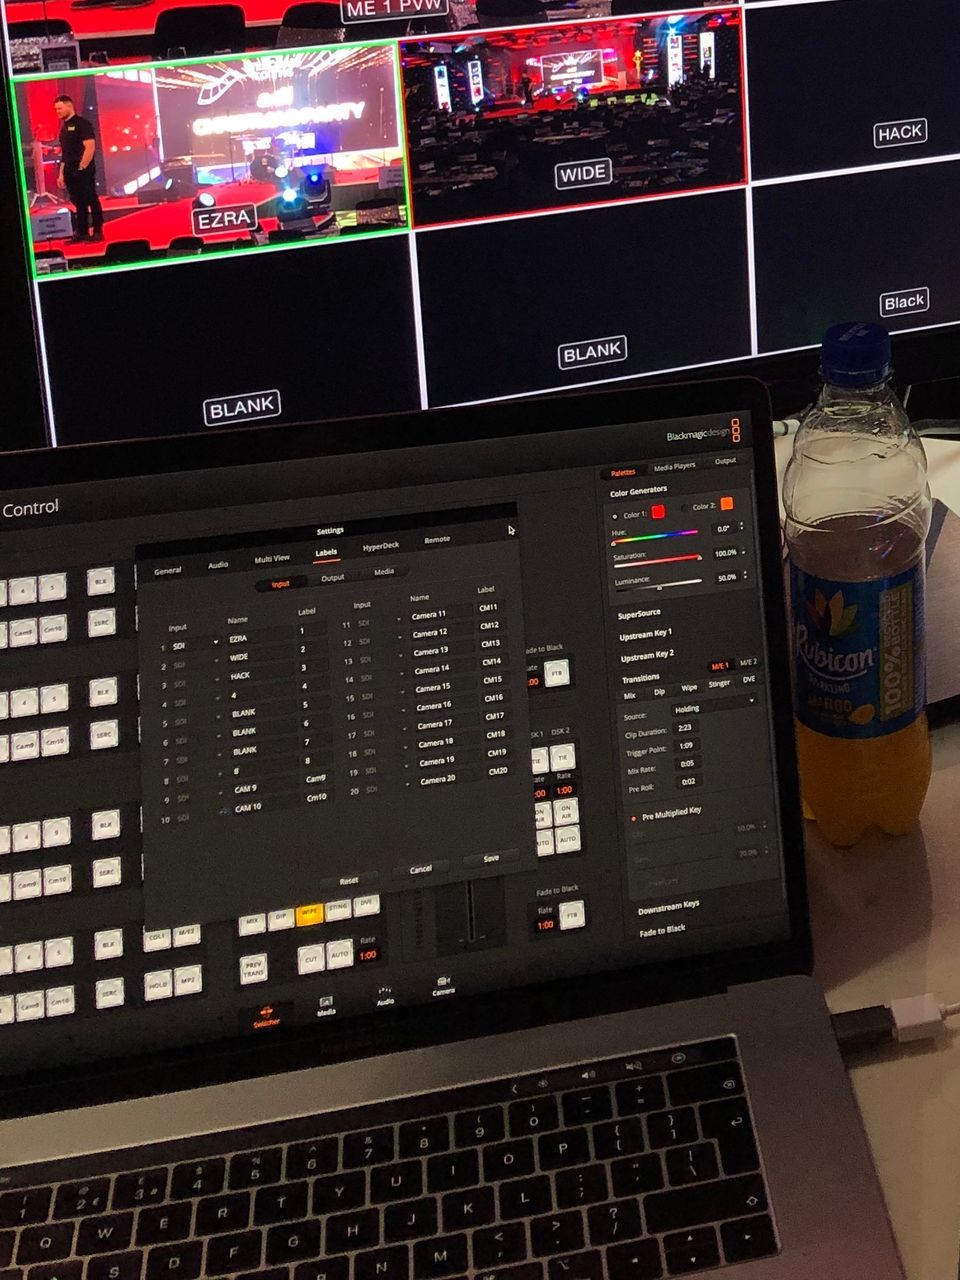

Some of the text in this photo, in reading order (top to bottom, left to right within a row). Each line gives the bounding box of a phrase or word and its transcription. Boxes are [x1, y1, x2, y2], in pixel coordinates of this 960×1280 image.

[347, 0, 376, 17] ME
[878, 123, 922, 141] HACK
[560, 163, 606, 182] WIDE
[197, 209, 250, 231] EZRA
[885, 293, 924, 311] Black
[563, 341, 622, 362] BLANK
[209, 395, 274, 419] BLANK
[654, 461, 696, 472] Media Players
[715, 456, 737, 466] Output
[610, 468, 636, 478] Palettes
[610, 484, 668, 499] Color Generators
[2, 498, 59, 519] Control
[316, 526, 344, 536] Settings
[424, 534, 450, 544] Remote
[362, 540, 400, 552] HyperDeck
[315, 547, 338, 558] Labels
[715, 548, 737, 558] 100.0%
[208, 559, 229, 569] Audio
[254, 553, 290, 564] Multi View
[154, 566, 182, 577] General
[614, 575, 650, 586] Luminance:
[718, 573, 737, 582] 50.0%
[272, 580, 290, 589] Input
[298, 607, 316, 616] Label
[479, 603, 498, 612] CM11
[411, 609, 446, 621] Camera 11
[618, 608, 661, 620] SuperSource
[480, 621, 499, 630] CM12
[229, 634, 247, 643] EZRA
[412, 627, 447, 639] Camera 12
[619, 630, 653, 642] Upstream
[654, 628, 667, 638] Key
[796, 623, 875, 672] Rubicon
[230, 652, 248, 662] WIDE
[620, 649, 675, 663] Upstream Key 2
[230, 671, 250, 680] HACK
[622, 672, 660, 684] Transitions
[742, 675, 756, 684] DVE
[681, 683, 698, 693] Wipe
[708, 679, 731, 690] Stinger
[623, 691, 636, 701] Mix
[654, 688, 666, 697] Dip
[232, 707, 256, 717] BLANK
[675, 703, 699, 715] Holding
[678, 723, 692, 732] 2:23
[625, 730, 637, 741] Clip
[679, 741, 693, 750] 1:09
[626, 747, 647, 758] Trigger
[680, 759, 694, 768] 0:05
[488, 766, 507, 776] CM20
[627, 767, 639, 776] Mix
[420, 774, 456, 786] Camera 20
[682, 777, 696, 786] 0:02
[235, 804, 251, 813] CAM
[642, 806, 702, 821] Pre Multiplied Key
[484, 854, 499, 863] Save
[409, 864, 433, 874] Cancel
[339, 876, 359, 885] Reset
[638, 899, 700, 916] Downstream Keys
[537, 920, 553, 930] 1:00
[639, 922, 686, 938] Fade to Black
[360, 950, 376, 961] 1:00
[419, 1138, 429, 1149] 8
[558, 1143, 568, 1154] P
[363, 1147, 373, 1160] 7
[503, 1153, 514, 1165] O
[463, 1203, 474, 1214] K
[434, 1250, 447, 1262] M
